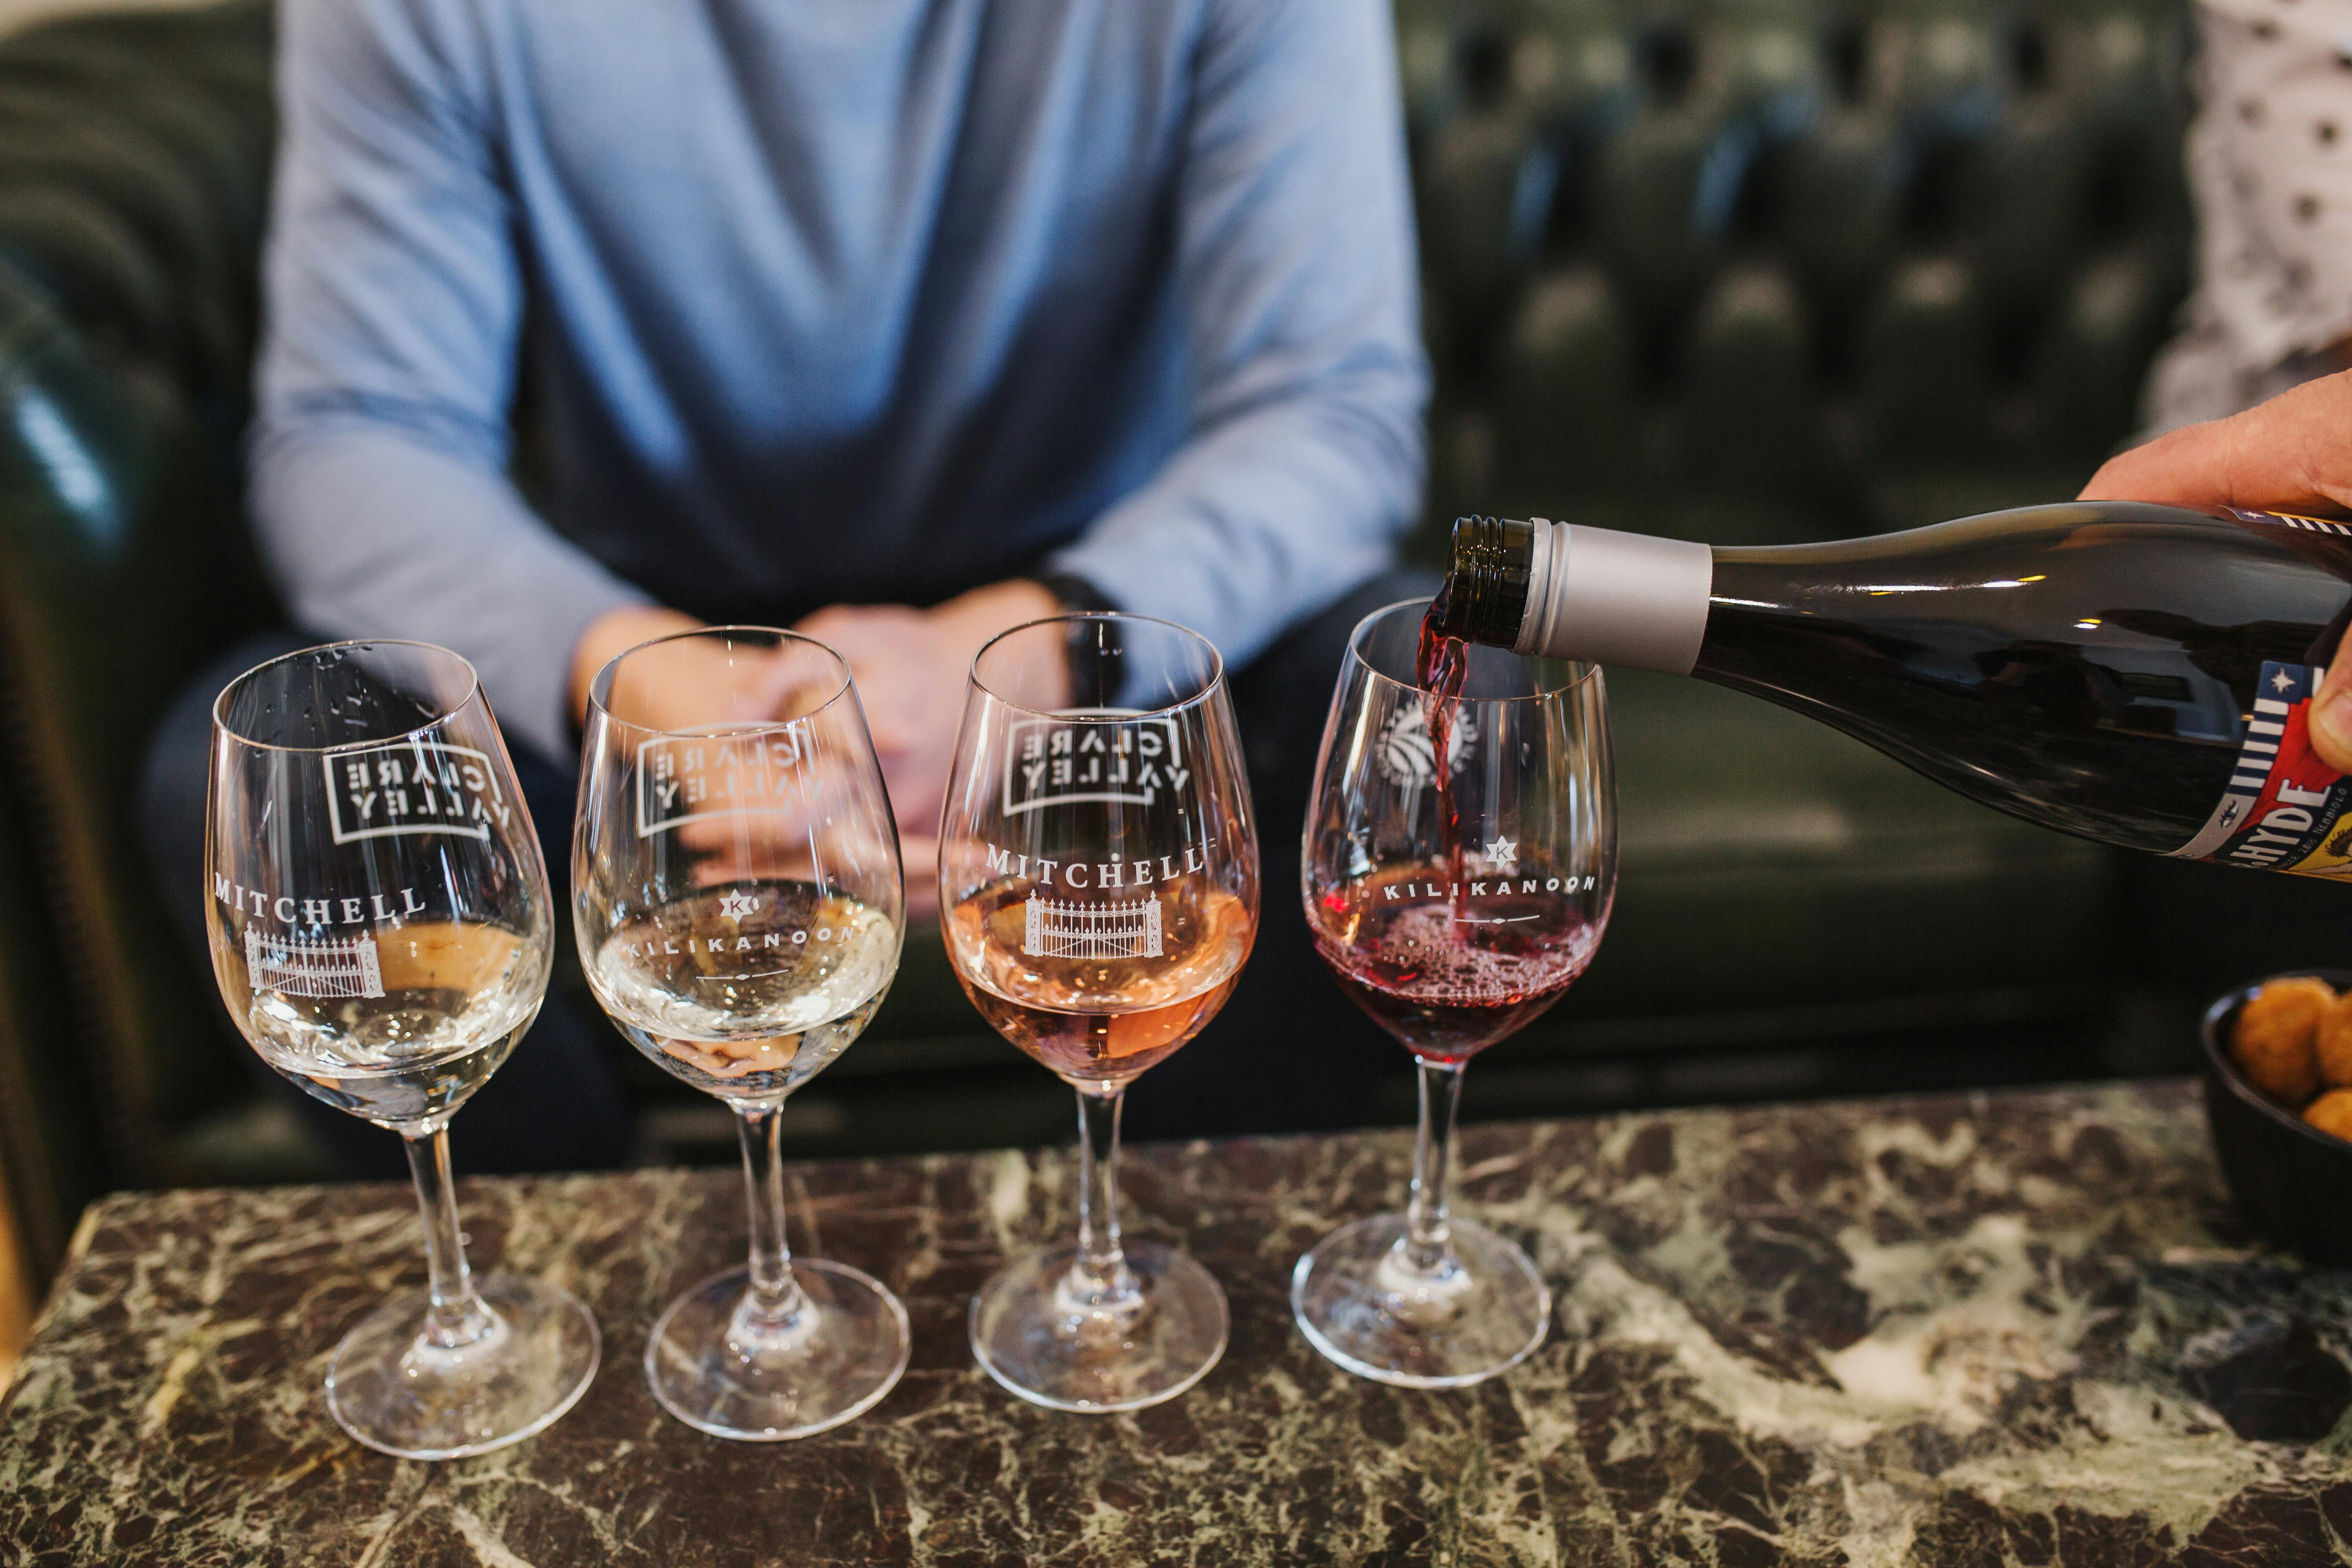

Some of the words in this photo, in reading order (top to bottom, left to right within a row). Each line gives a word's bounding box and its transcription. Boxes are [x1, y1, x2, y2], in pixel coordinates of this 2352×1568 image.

[2230, 778, 2332, 862] HYDE
[986, 843, 1203, 889] MITCHELL
[1496, 846, 1508, 859] K
[214, 872, 425, 925] MITCHELL
[1383, 876, 1596, 901] KILIKANOON
[730, 900, 743, 914] K
[626, 926, 855, 959] KILIKANOON
